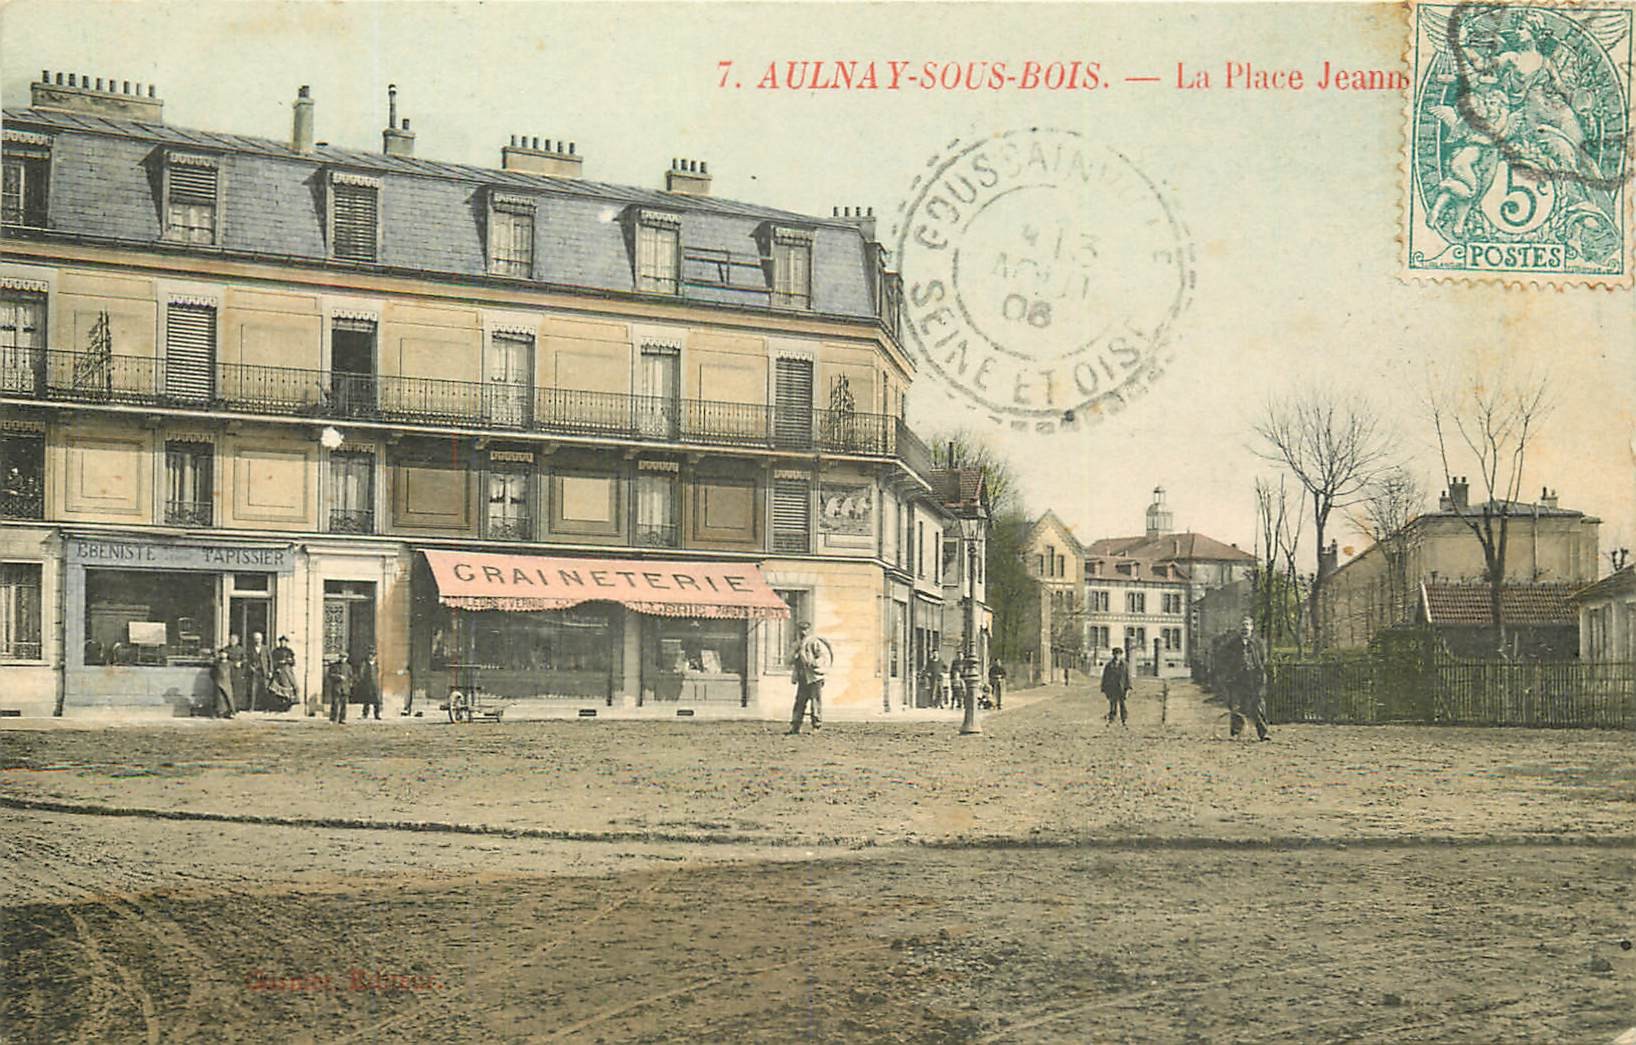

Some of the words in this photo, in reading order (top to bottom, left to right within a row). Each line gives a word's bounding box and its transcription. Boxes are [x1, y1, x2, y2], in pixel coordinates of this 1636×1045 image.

[1499, 161, 1549, 228] 5
[1470, 244, 1562, 269] POSTES
[201, 545, 285, 566] TAPISSIER
[453, 562, 756, 594] GRAINETERIE
